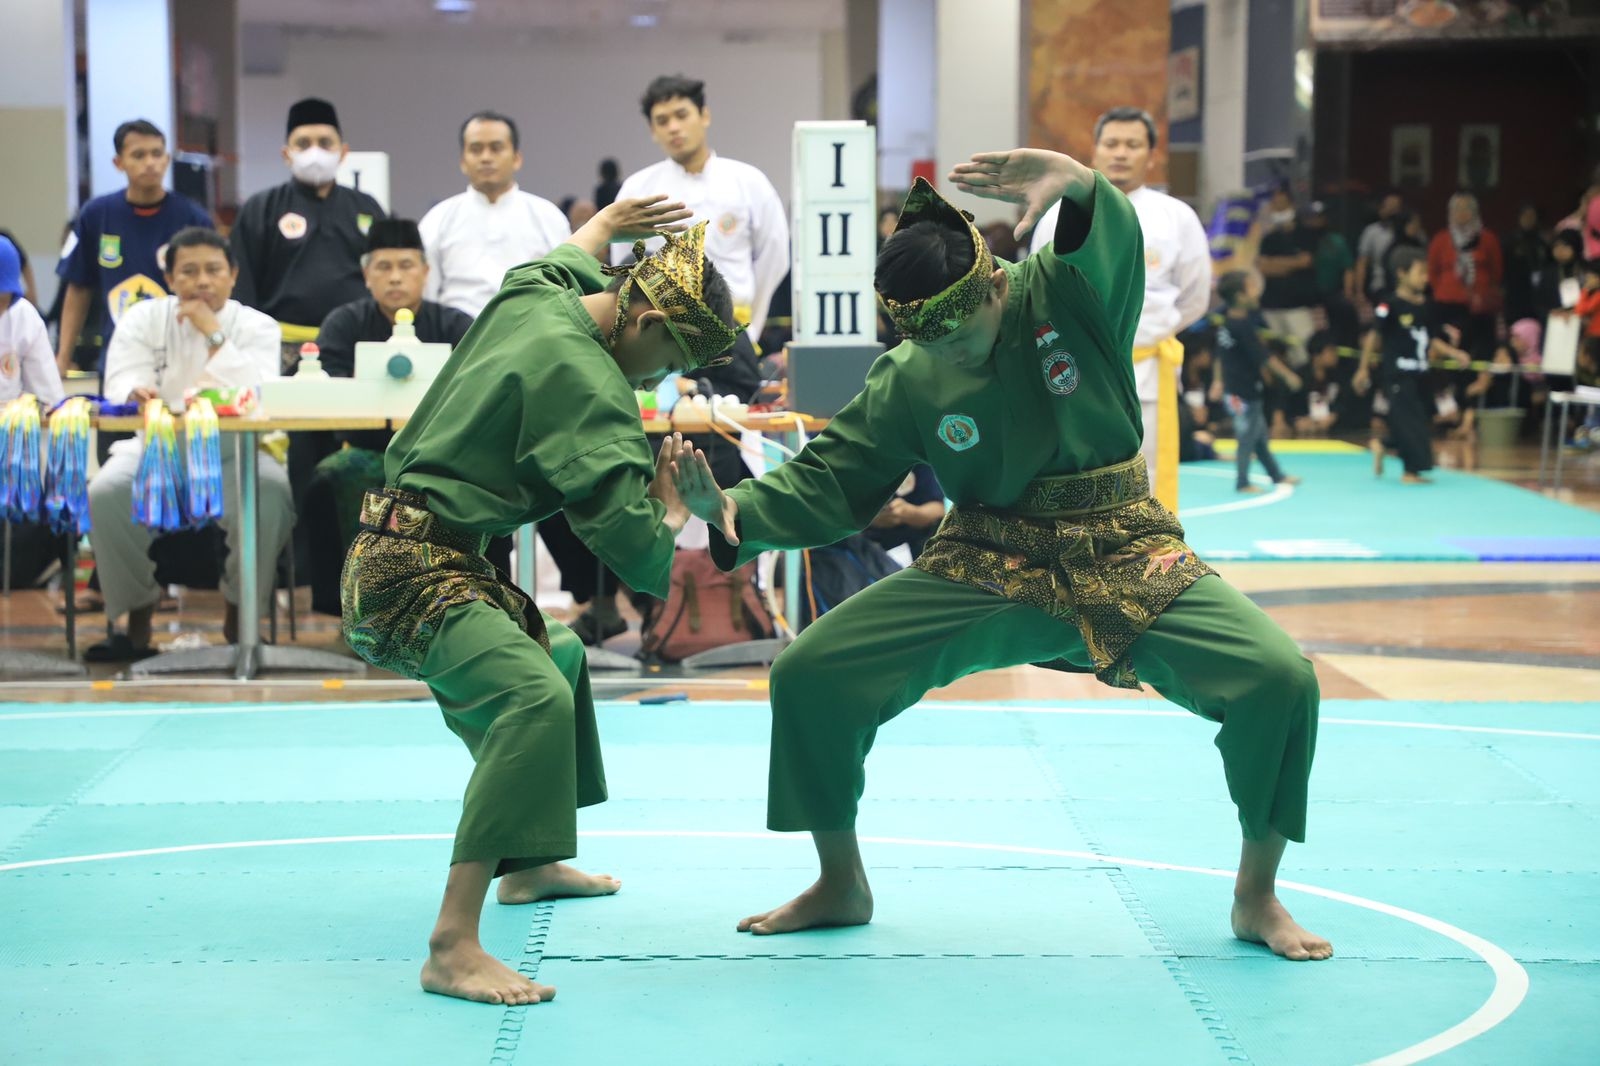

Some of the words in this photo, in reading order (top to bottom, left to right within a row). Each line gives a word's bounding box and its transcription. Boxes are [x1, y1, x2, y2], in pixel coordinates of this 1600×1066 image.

[831, 142, 846, 188] I
[818, 212, 852, 256] II
[815, 291, 861, 335] III
